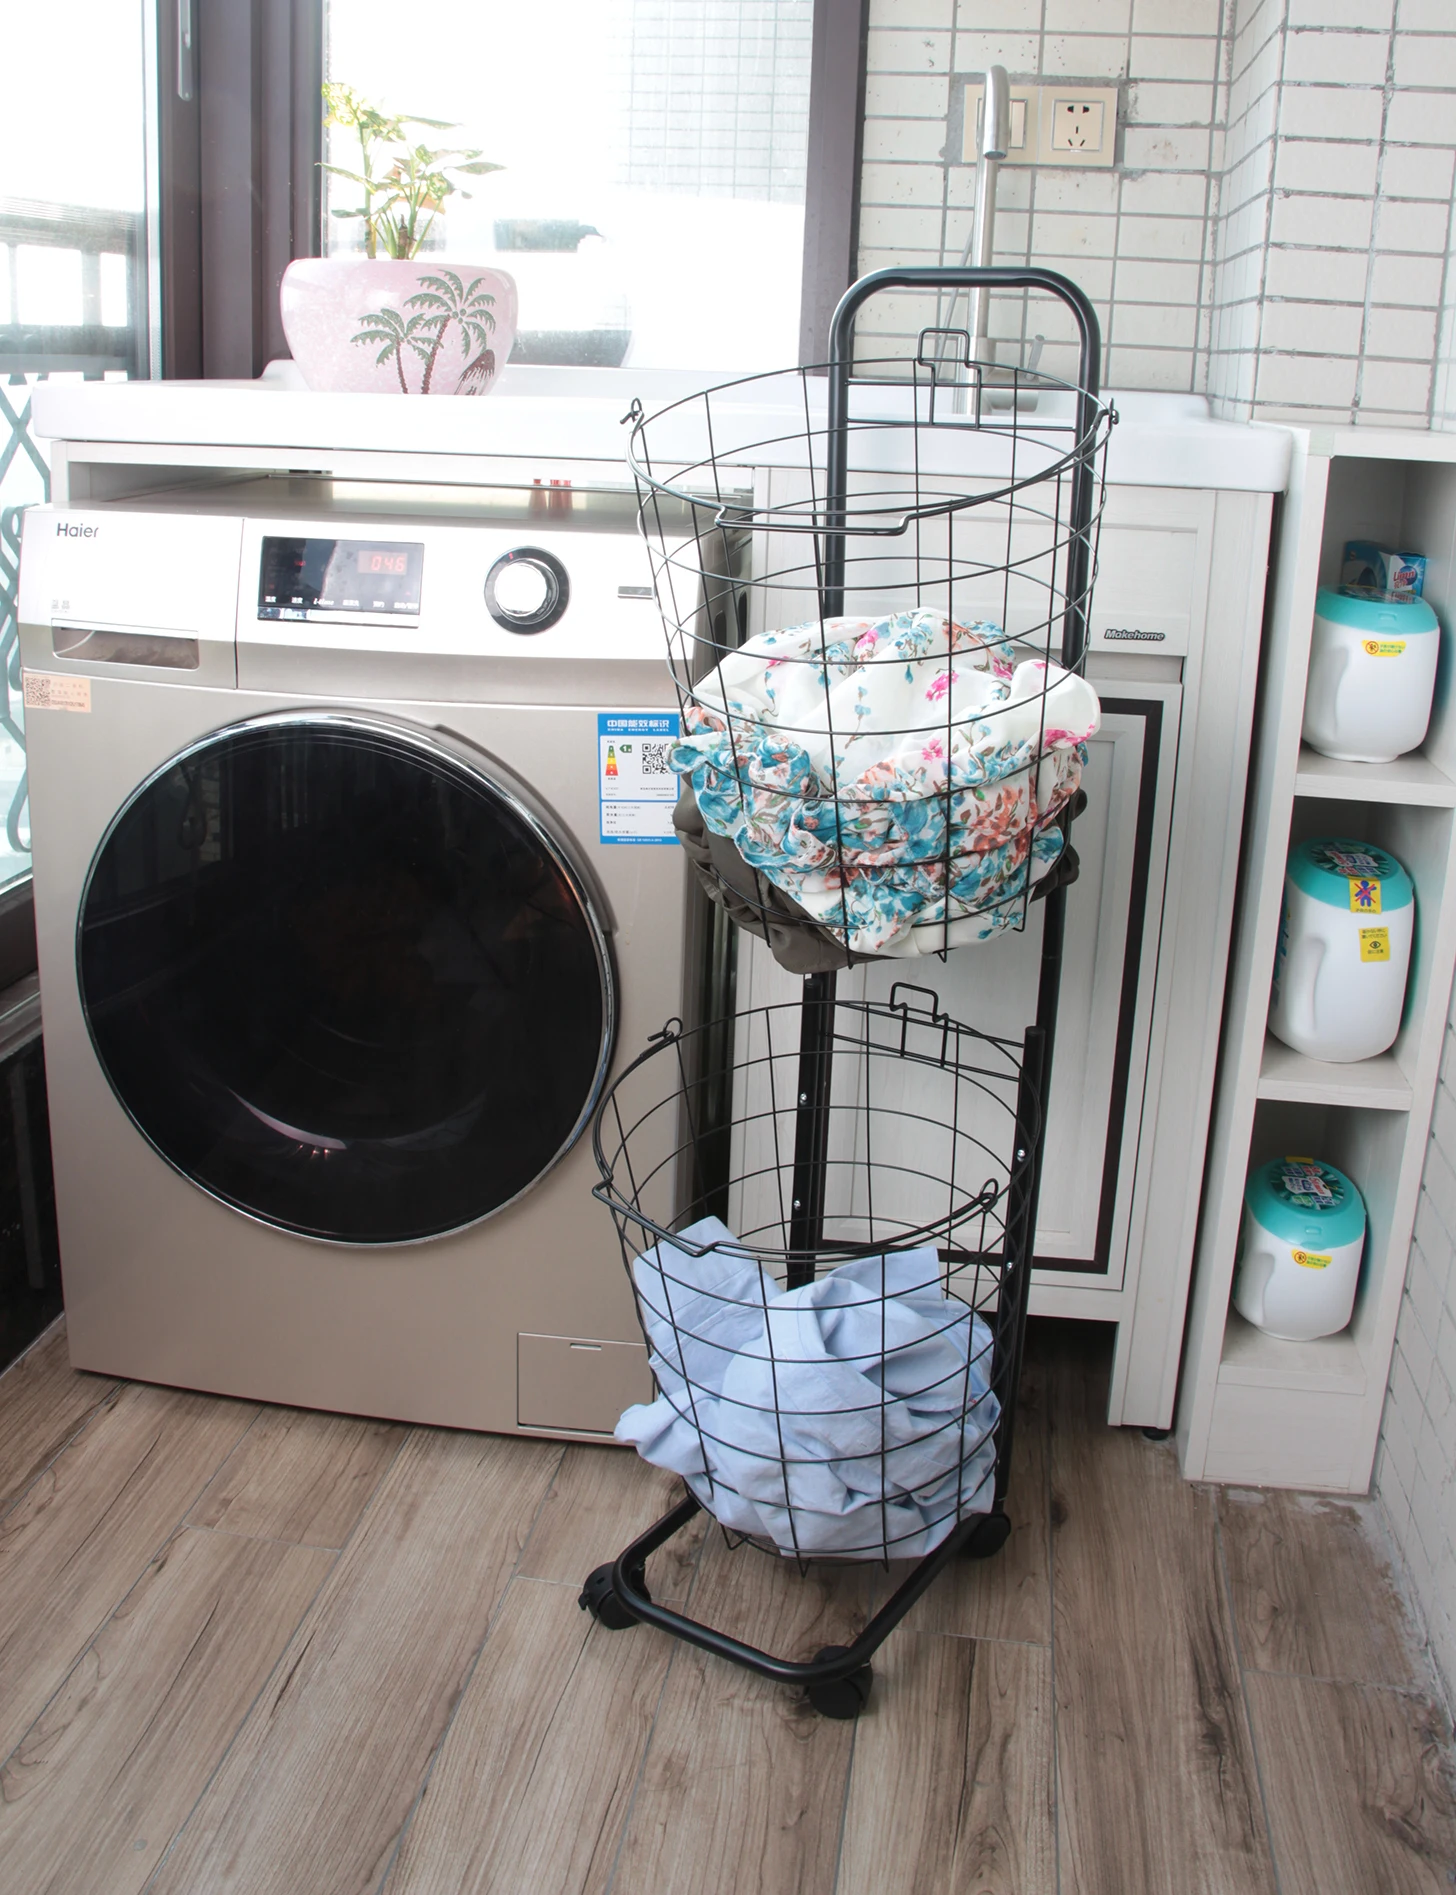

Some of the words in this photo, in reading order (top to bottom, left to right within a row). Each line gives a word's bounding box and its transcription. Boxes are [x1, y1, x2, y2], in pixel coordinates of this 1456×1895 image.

[56, 522, 99, 538] Haier
[1104, 629, 1165, 641] Makehome
[607, 719, 670, 728] 中国能效标识
